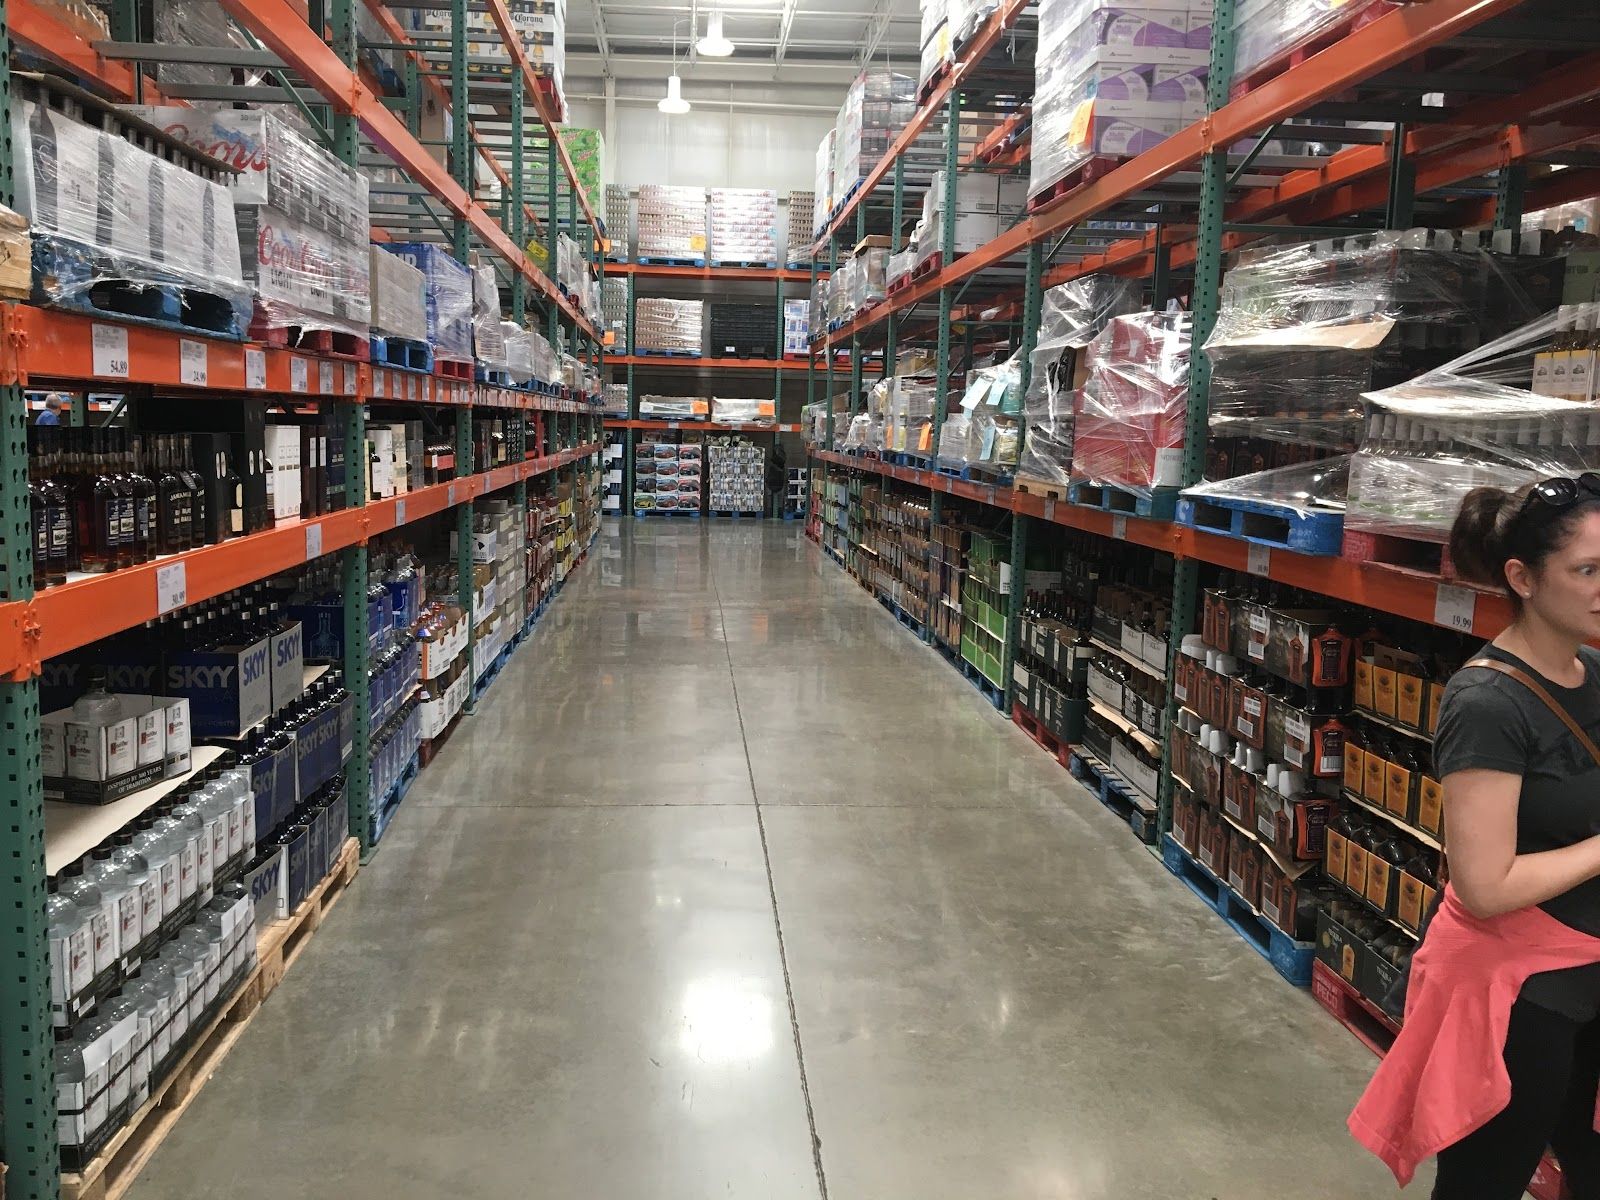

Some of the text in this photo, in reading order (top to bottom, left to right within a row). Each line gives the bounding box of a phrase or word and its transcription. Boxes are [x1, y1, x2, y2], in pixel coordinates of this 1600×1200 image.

[515, 14, 543, 23] Corona
[110, 360, 128, 374] 54.89
[1452, 615, 1472, 630] 19.99
[277, 630, 300, 667] SKYY
[168, 665, 234, 688] SKYY
[243, 647, 266, 686] SKYY
[107, 776, 131, 791] INSPIRED
[131, 774, 138, 782] BY
[146, 765, 162, 776] YEARS
[118, 776, 152, 793] OF TRADITION
[252, 858, 281, 905] SKYY
